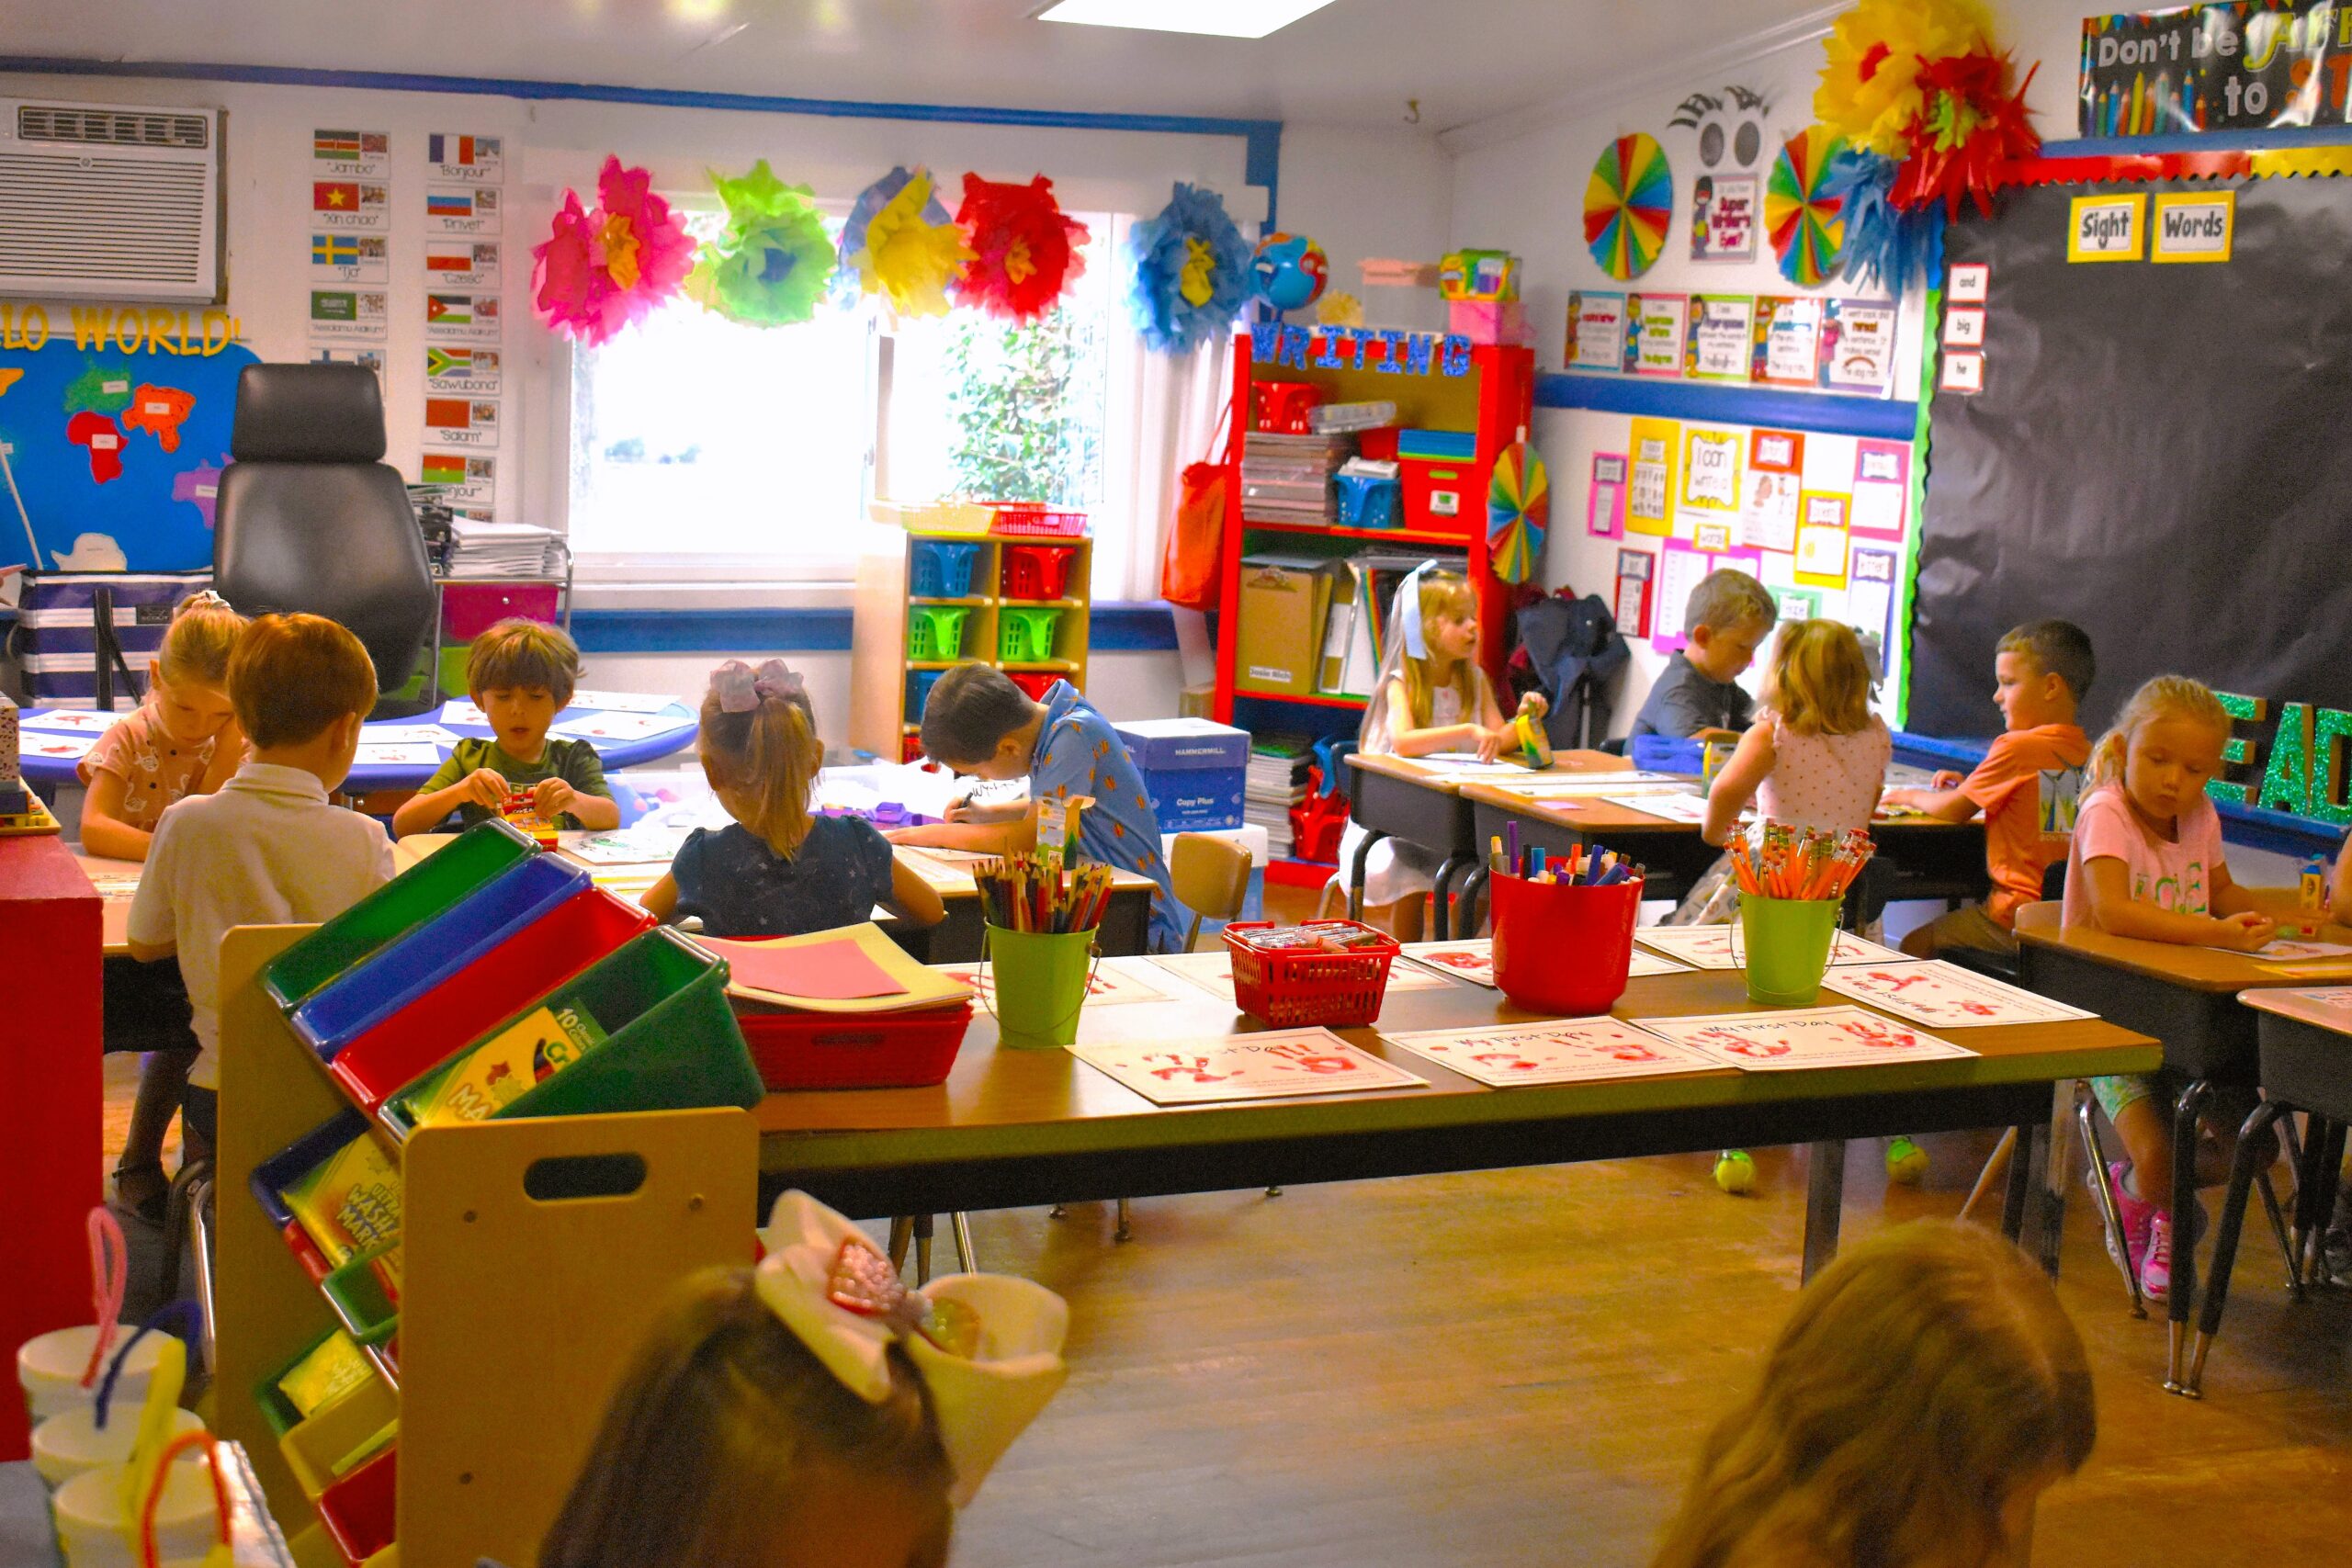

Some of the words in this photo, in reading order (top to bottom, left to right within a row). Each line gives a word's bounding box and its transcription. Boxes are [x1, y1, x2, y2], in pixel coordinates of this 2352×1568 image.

[2098, 28, 2181, 68] Don't
[2191, 26, 2238, 58] be
[2224, 75, 2268, 117] to
[2082, 211, 2131, 249] Sight
[2164, 210, 2223, 239] Words
[1960, 276, 1975, 288] and
[71, 307, 242, 357] WORLD!
[1956, 319, 1971, 334] big
[1250, 321, 1472, 378] WRITING
[1956, 362, 1967, 375] he
[557, 1008, 579, 1029] 10
